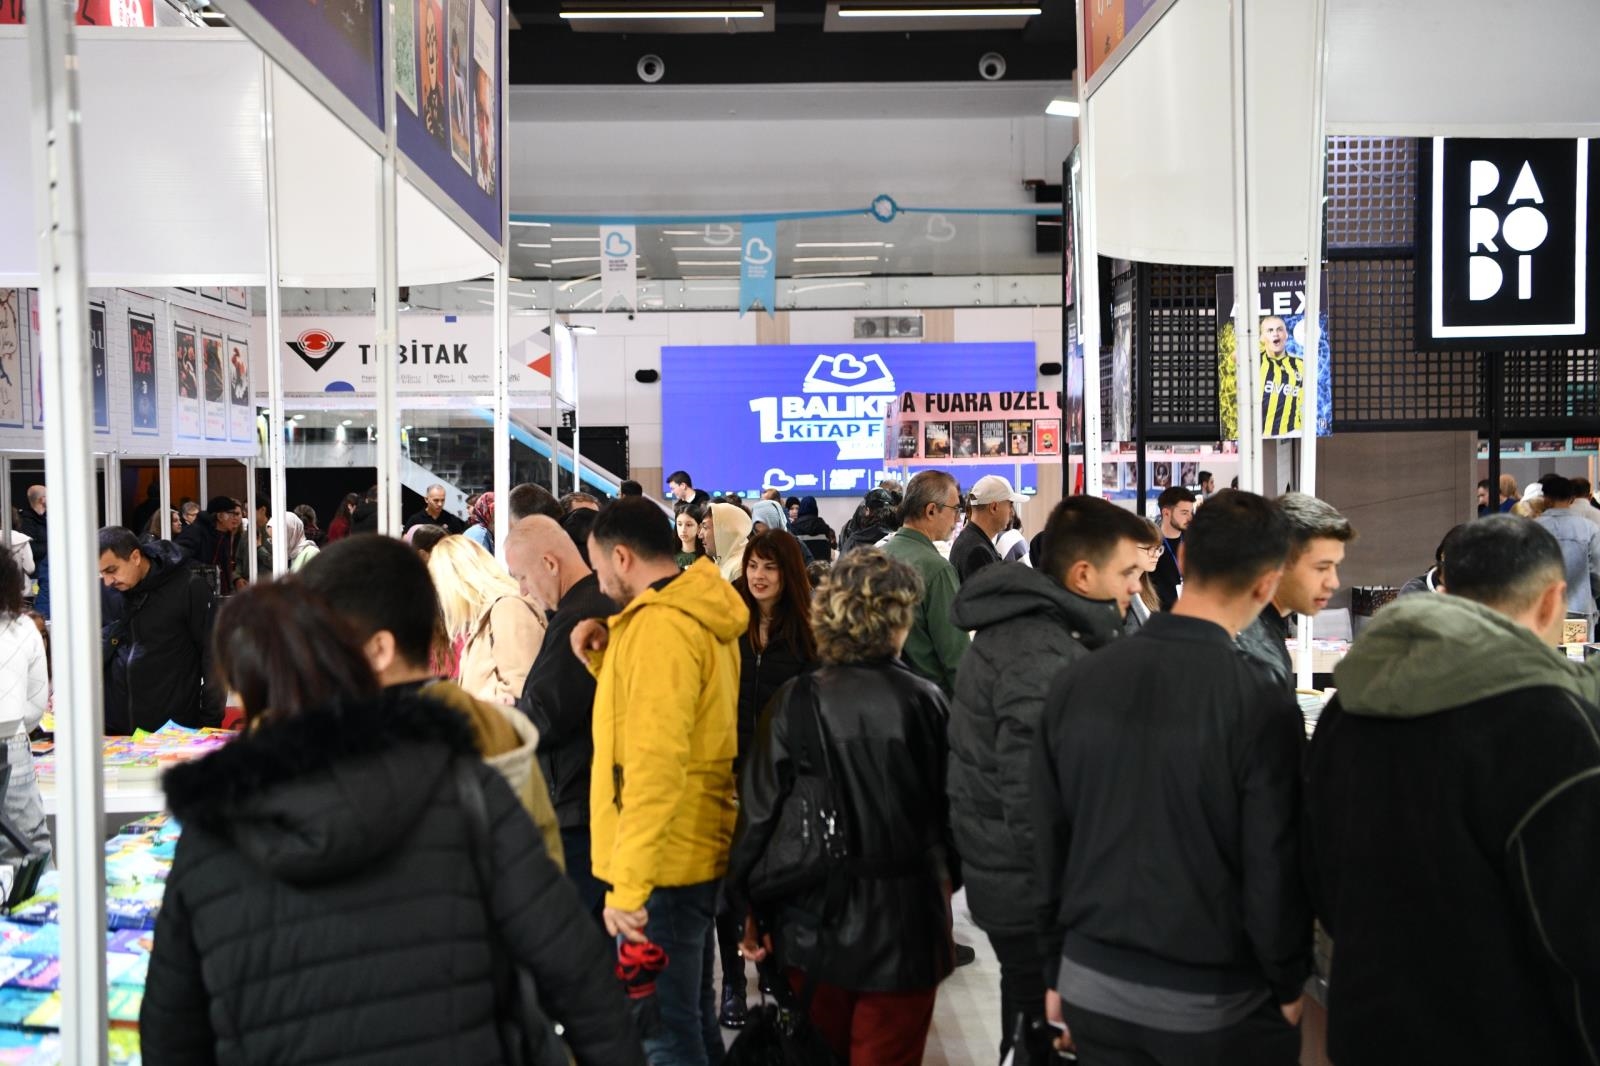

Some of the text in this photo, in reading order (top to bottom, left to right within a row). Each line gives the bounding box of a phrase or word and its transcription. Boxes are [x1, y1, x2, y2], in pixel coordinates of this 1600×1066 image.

[358, 340, 468, 365] TBİTAK
[925, 391, 993, 413] FUARA
[868, 423, 881, 437] F
